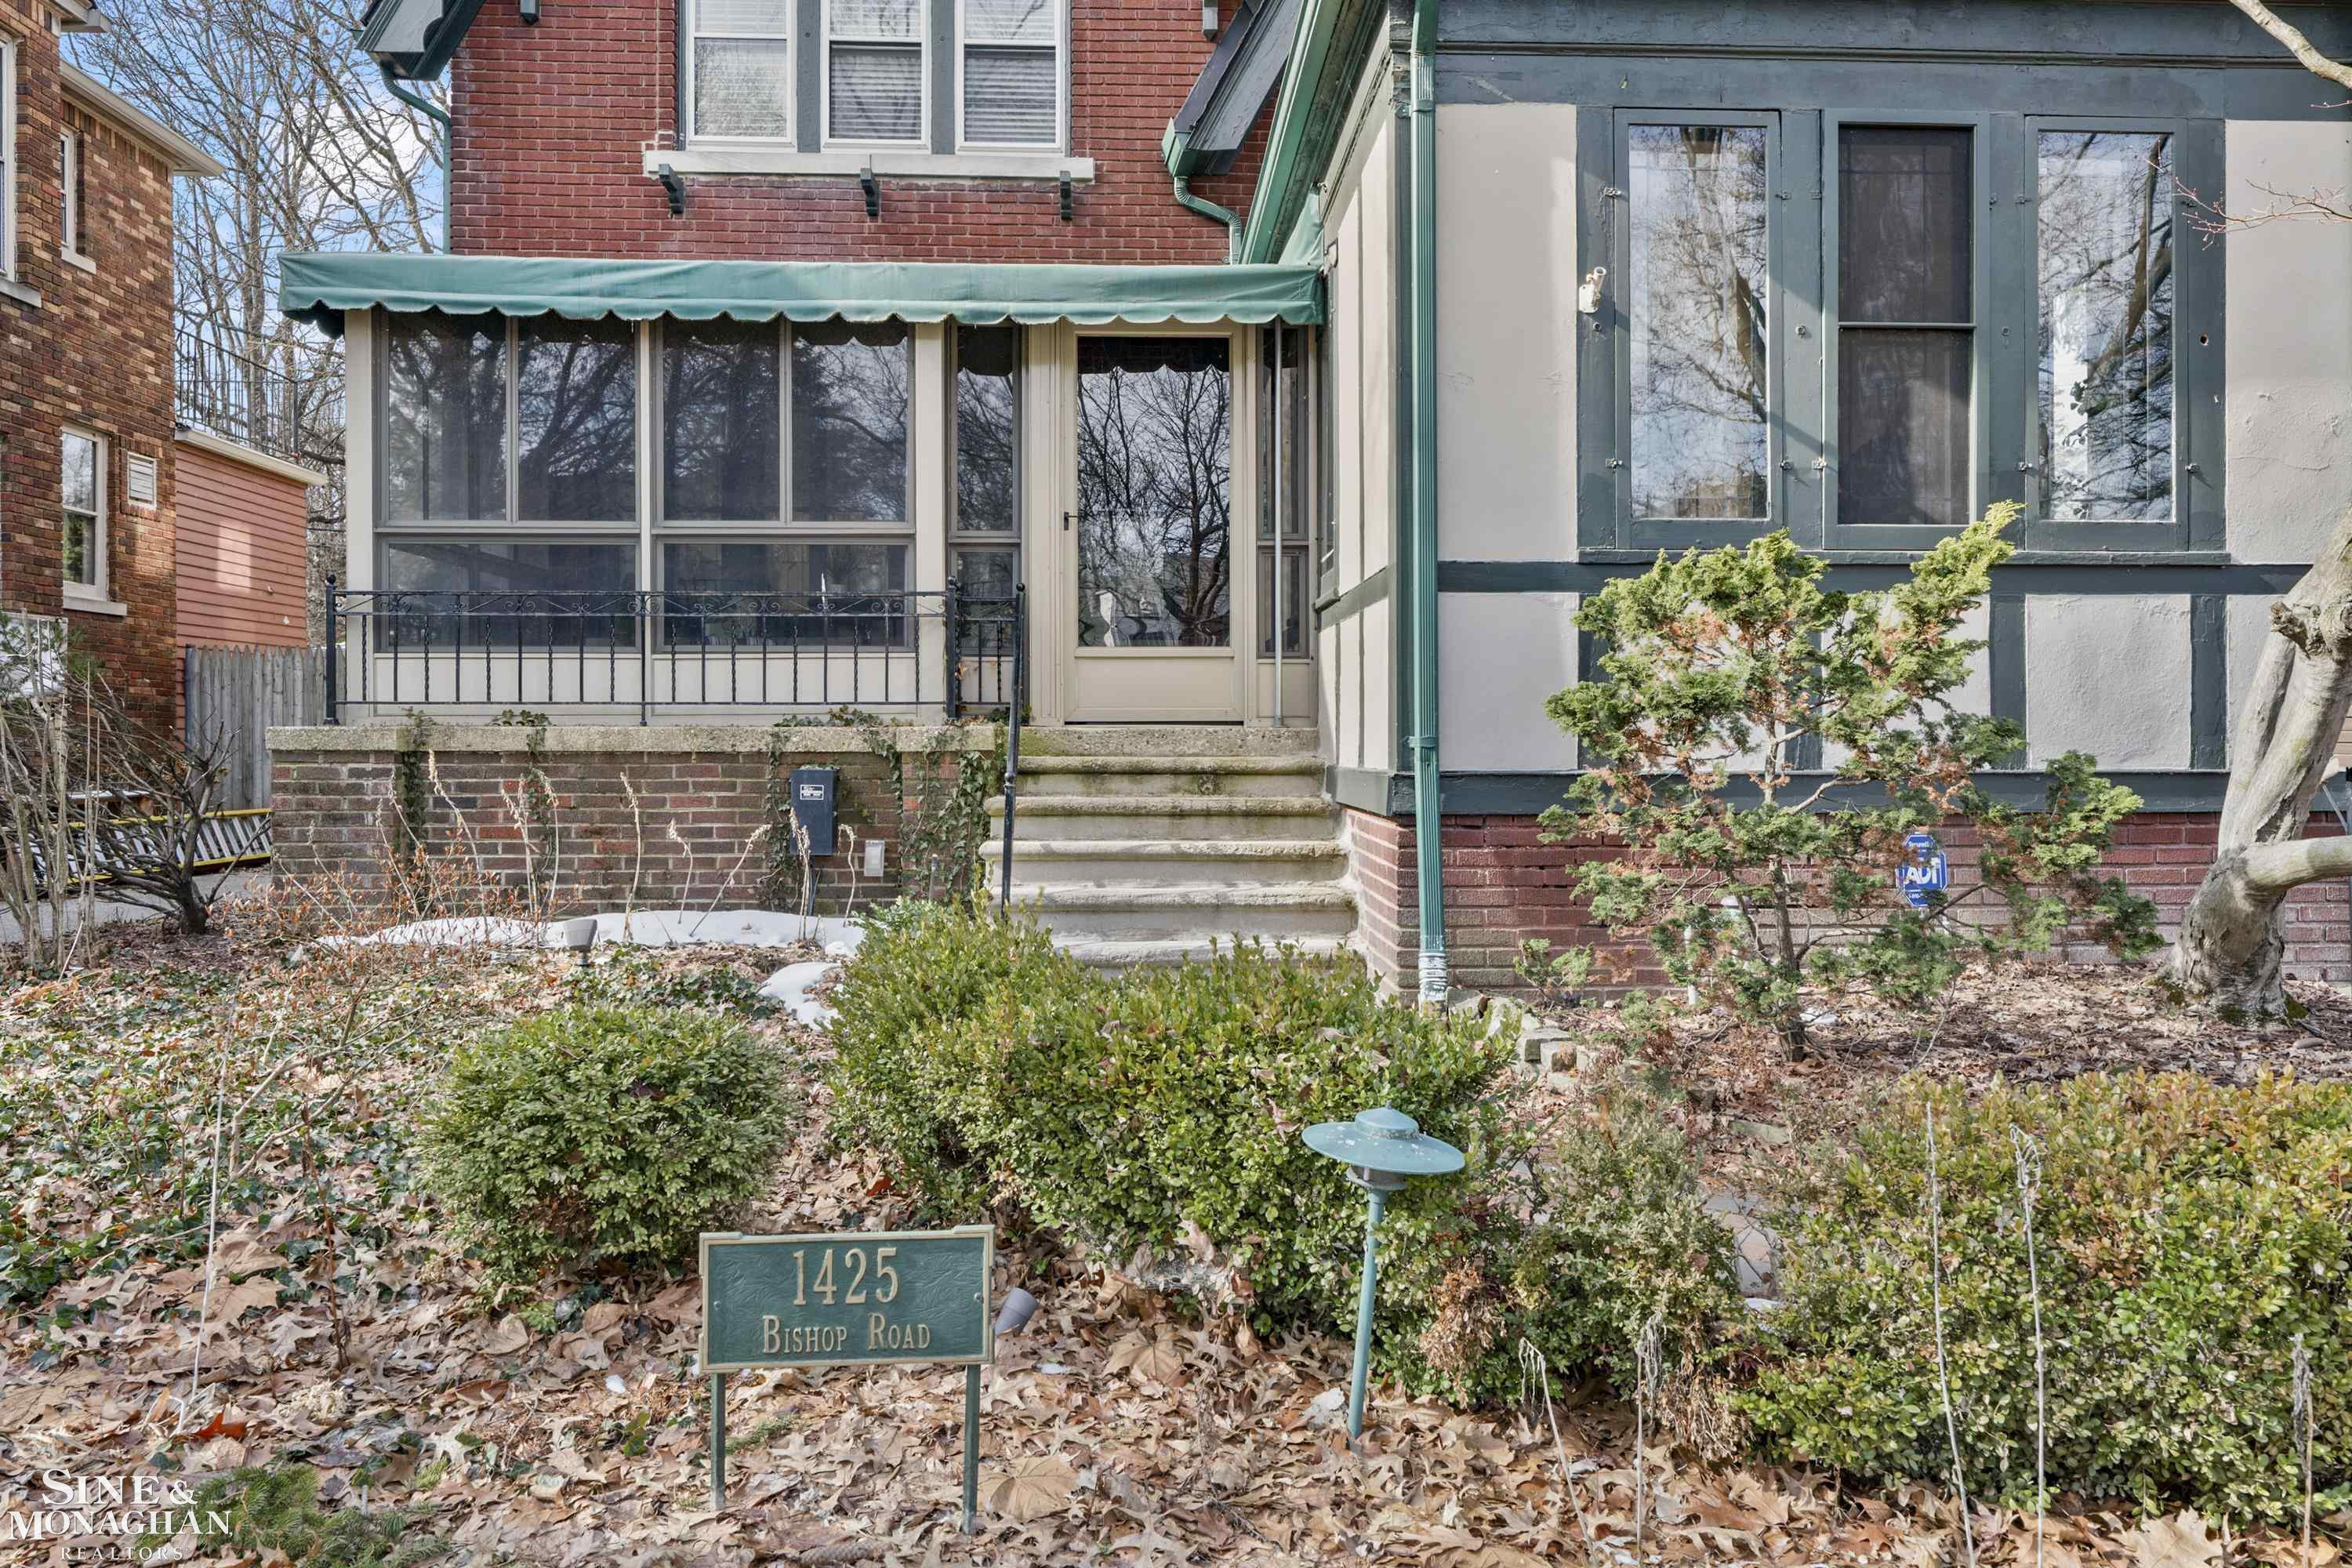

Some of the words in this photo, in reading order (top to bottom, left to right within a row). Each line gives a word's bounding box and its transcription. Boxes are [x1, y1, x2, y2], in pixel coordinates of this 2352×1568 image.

[1904, 857, 1941, 885] ADT
[793, 1247, 899, 1305] 1425
[762, 1314, 848, 1354] BISHOP
[868, 1311, 931, 1350] ROAD
